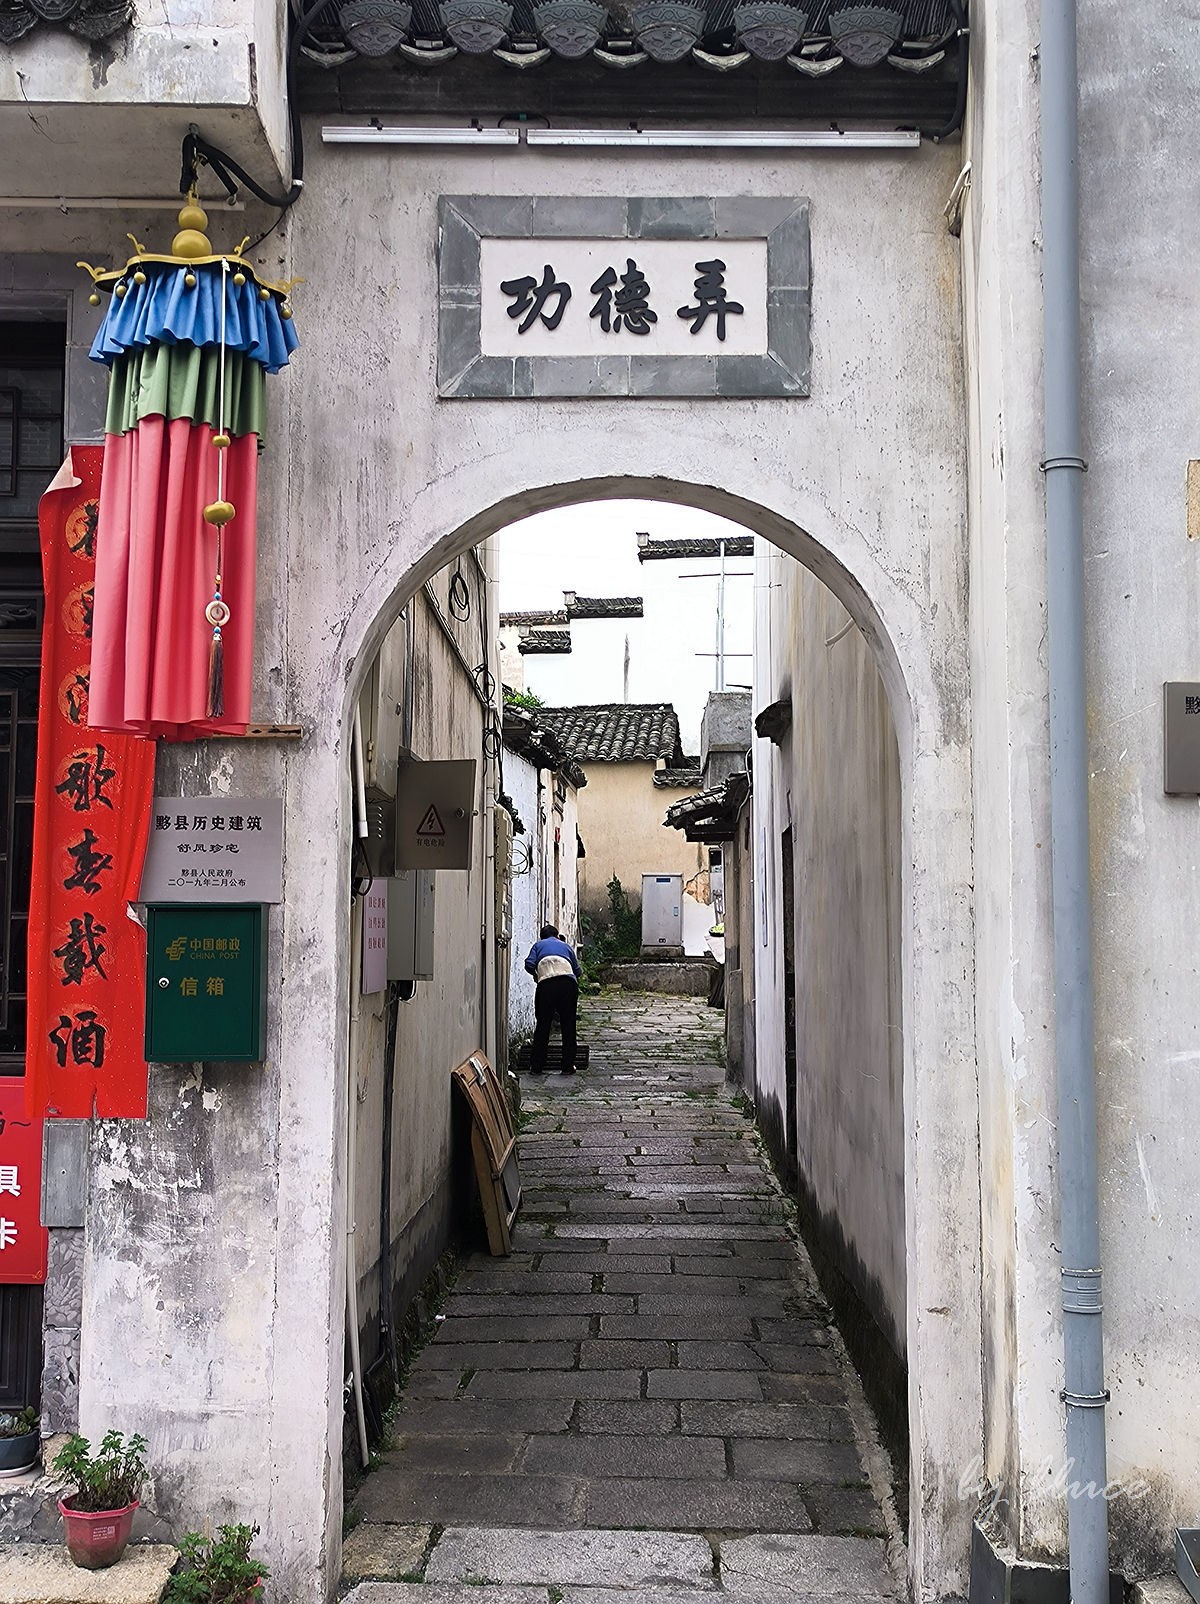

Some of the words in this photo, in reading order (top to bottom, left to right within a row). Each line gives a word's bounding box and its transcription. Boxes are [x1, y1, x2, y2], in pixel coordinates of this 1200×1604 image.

[499, 257, 745, 342] 功德弄
[155, 815, 262, 831] 黟县历史建筑
[181, 868, 233, 878] 黟县人民政府
[190, 937, 241, 951] 中国邮政
[190, 952, 216, 960] CHINA
[219, 952, 240, 960] POST
[179, 976, 225, 996] 信箱
